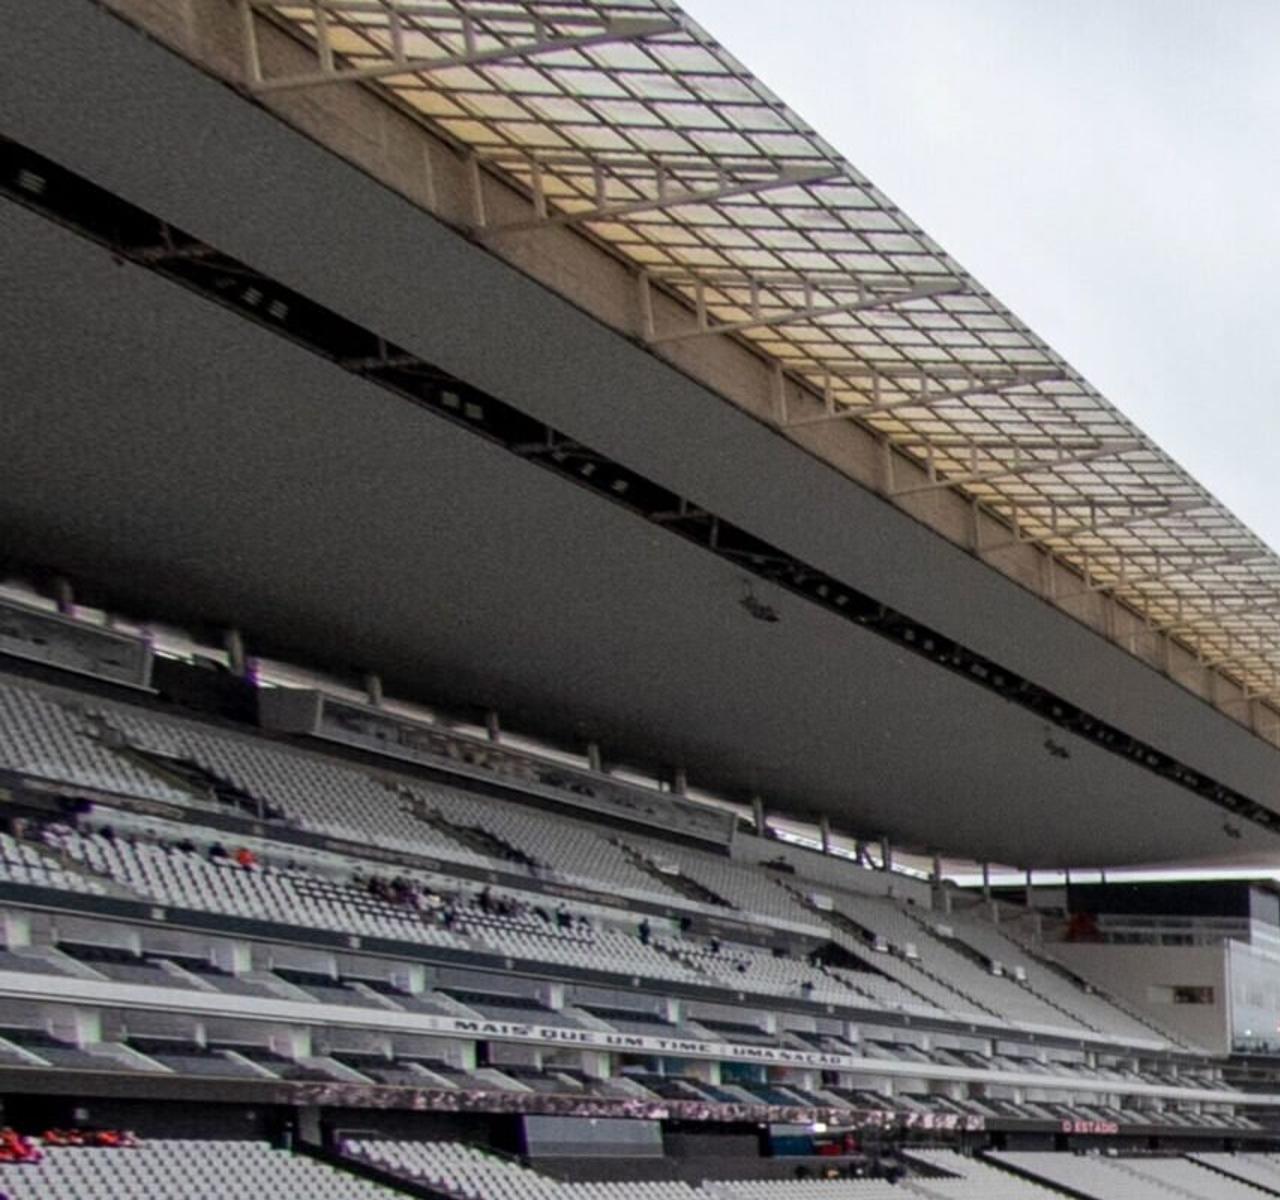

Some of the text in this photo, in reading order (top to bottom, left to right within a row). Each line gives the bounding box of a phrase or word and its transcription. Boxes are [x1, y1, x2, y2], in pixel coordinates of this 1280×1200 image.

[454, 1020, 531, 1037] MAIS
[541, 1030, 596, 1044] QUE
[606, 1036, 643, 1047] UM
[658, 1040, 712, 1052] TIME
[733, 1047, 775, 1059] UMA
[1062, 1119, 1072, 1134] O
